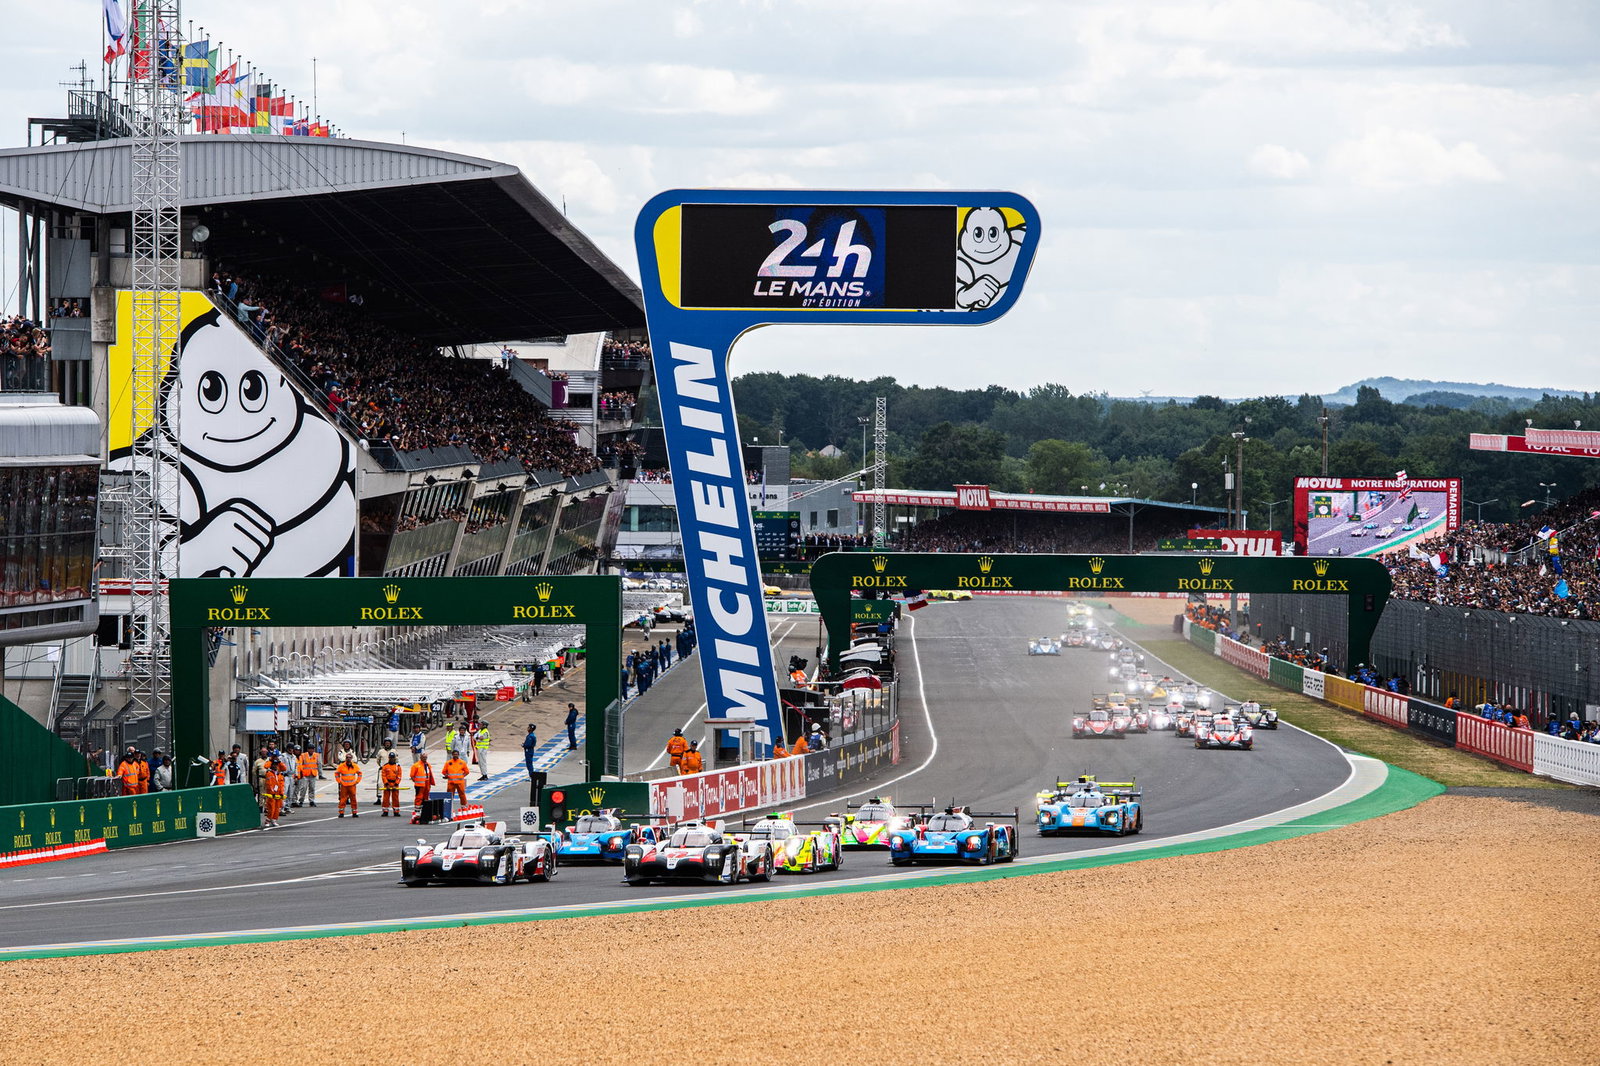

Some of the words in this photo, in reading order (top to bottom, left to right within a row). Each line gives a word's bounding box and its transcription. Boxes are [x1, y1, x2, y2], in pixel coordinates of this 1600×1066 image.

[757, 219, 872, 278] 24h
[753, 280, 786, 297] LE
[789, 280, 864, 297] MANS
[818, 297, 861, 308] ÉDITION
[1297, 477, 1343, 489] MOTUL
[1351, 479, 1383, 488] NOTRE
[1384, 480, 1447, 489] INSPIRATION
[959, 488, 989, 507] MOTUL
[1449, 480, 1458, 529] DEMARRE
[669, 341, 772, 746] MICHELIN
[1193, 537, 1278, 556] OTUL
[852, 575, 908, 588] ROLEX
[958, 576, 1013, 588] ROLEX
[1069, 577, 1124, 589] ROLEX
[1178, 578, 1233, 591] ROLEX
[1292, 579, 1349, 591] ROLEX
[207, 607, 271, 621] ROLEX
[360, 607, 423, 621] ROLEX
[512, 605, 576, 618] ROLEX
[683, 787, 699, 809] TOTAL
[705, 782, 719, 806] TOTAL
[725, 779, 739, 801] TOTAL
[744, 776, 758, 796] TOTAL
[13, 834, 32, 848] ROLEX
[45, 832, 62, 845] ROLEX
[74, 829, 91, 841] ROLEX
[102, 826, 119, 839] ROLEX
[128, 823, 143, 836] ROLEX
[152, 820, 166, 833] ROLEX
[174, 817, 188, 830] ROLEX
